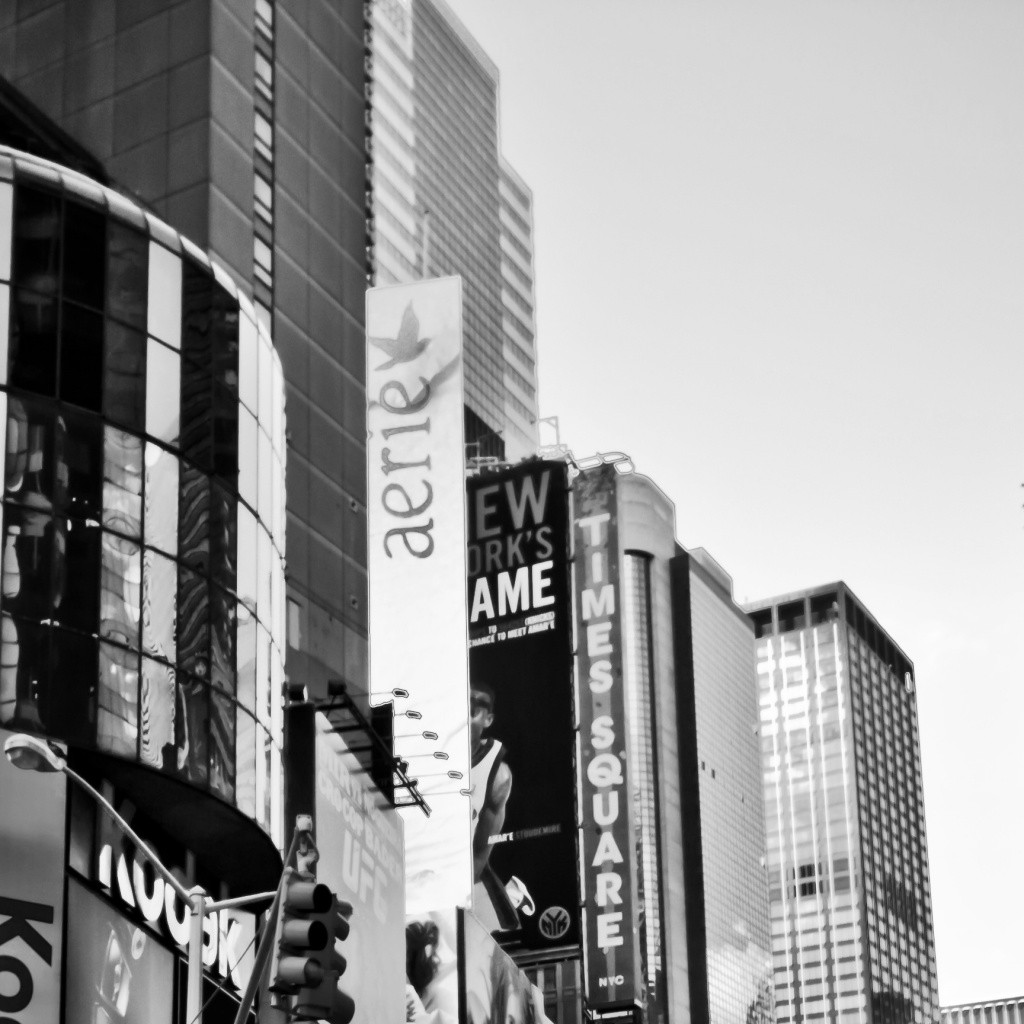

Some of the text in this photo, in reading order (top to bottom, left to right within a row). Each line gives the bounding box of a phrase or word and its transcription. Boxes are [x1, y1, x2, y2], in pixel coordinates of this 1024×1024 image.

[380, 376, 434, 558] aerie
[578, 512, 624, 948] TIMES SQUARE
[599, 975, 624, 987] NYC
